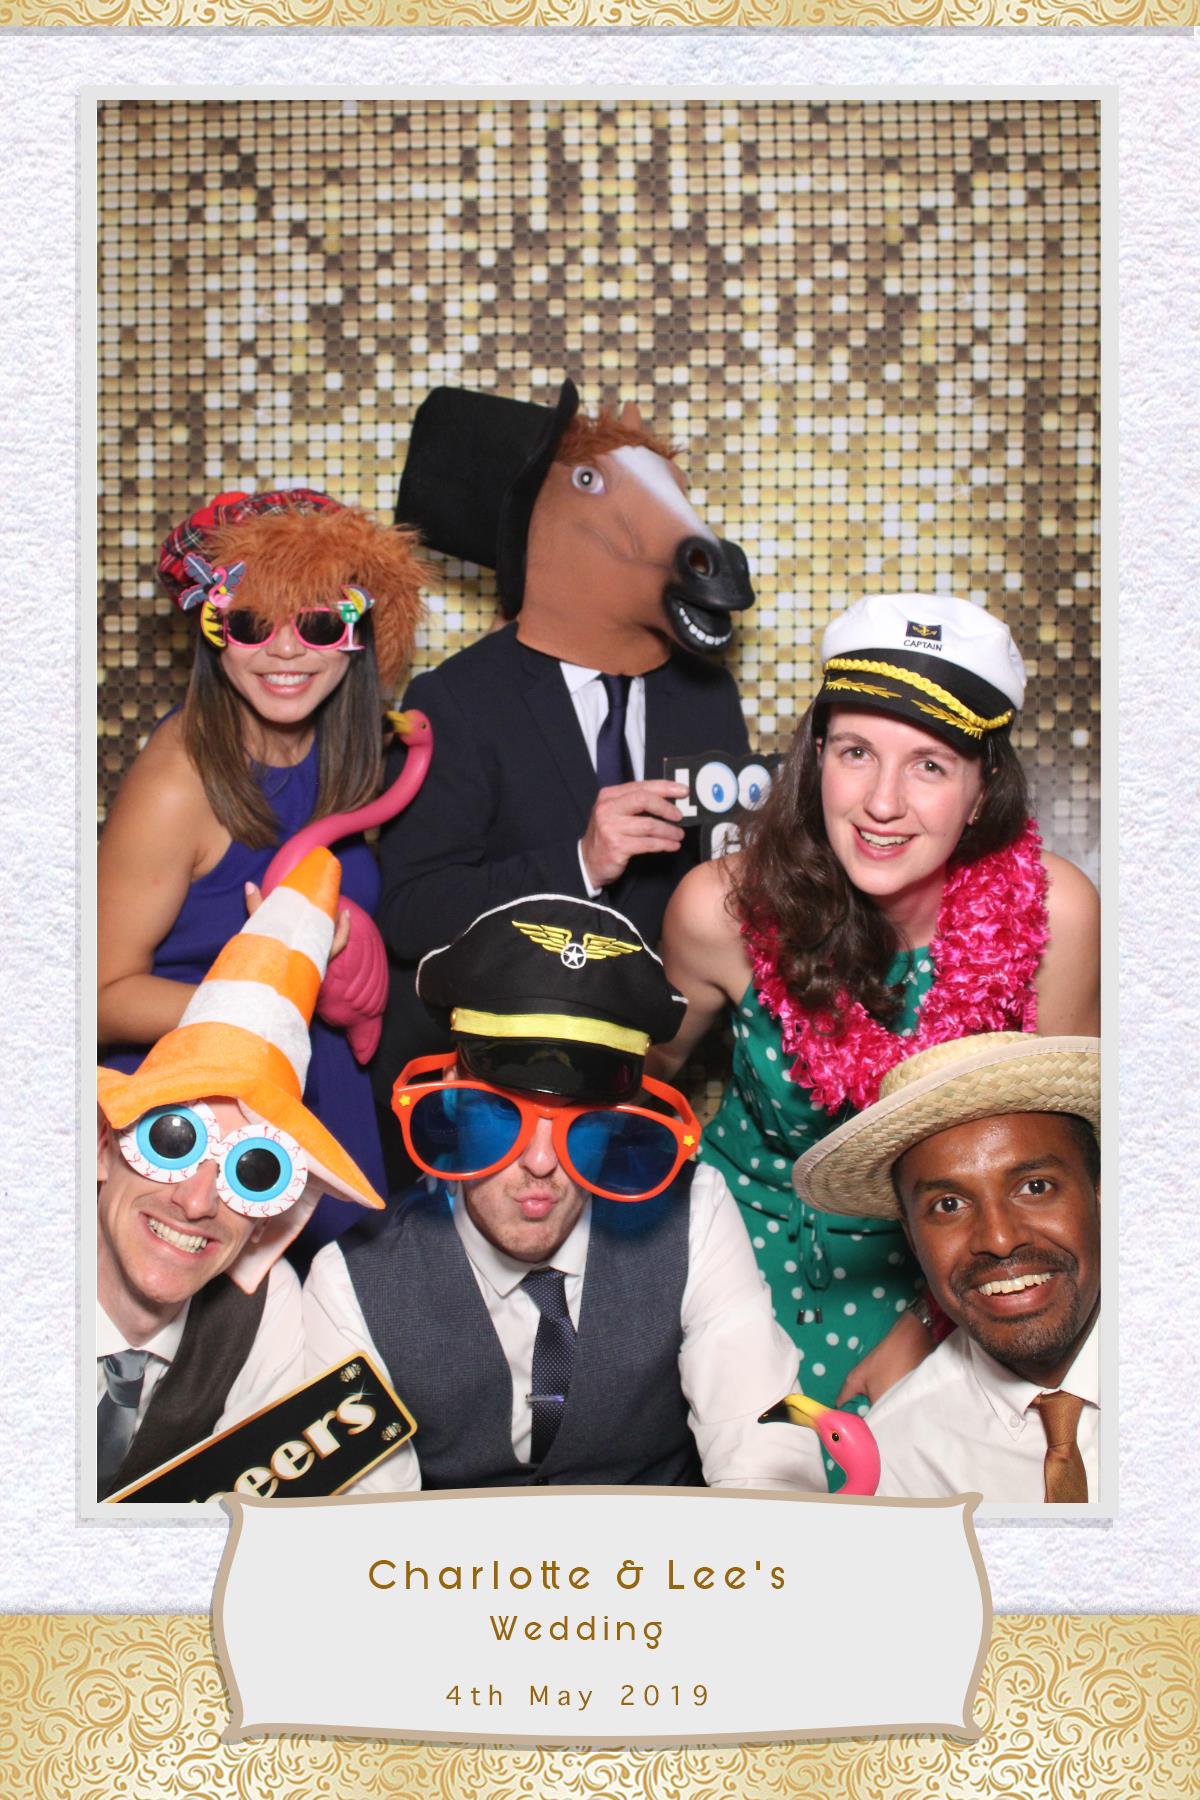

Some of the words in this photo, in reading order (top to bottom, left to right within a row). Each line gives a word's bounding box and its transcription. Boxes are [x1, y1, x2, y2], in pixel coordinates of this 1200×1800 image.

[903, 639, 942, 652] CAPTAIN
[674, 761, 785, 817] LOO
[192, 1394, 376, 1503] eers
